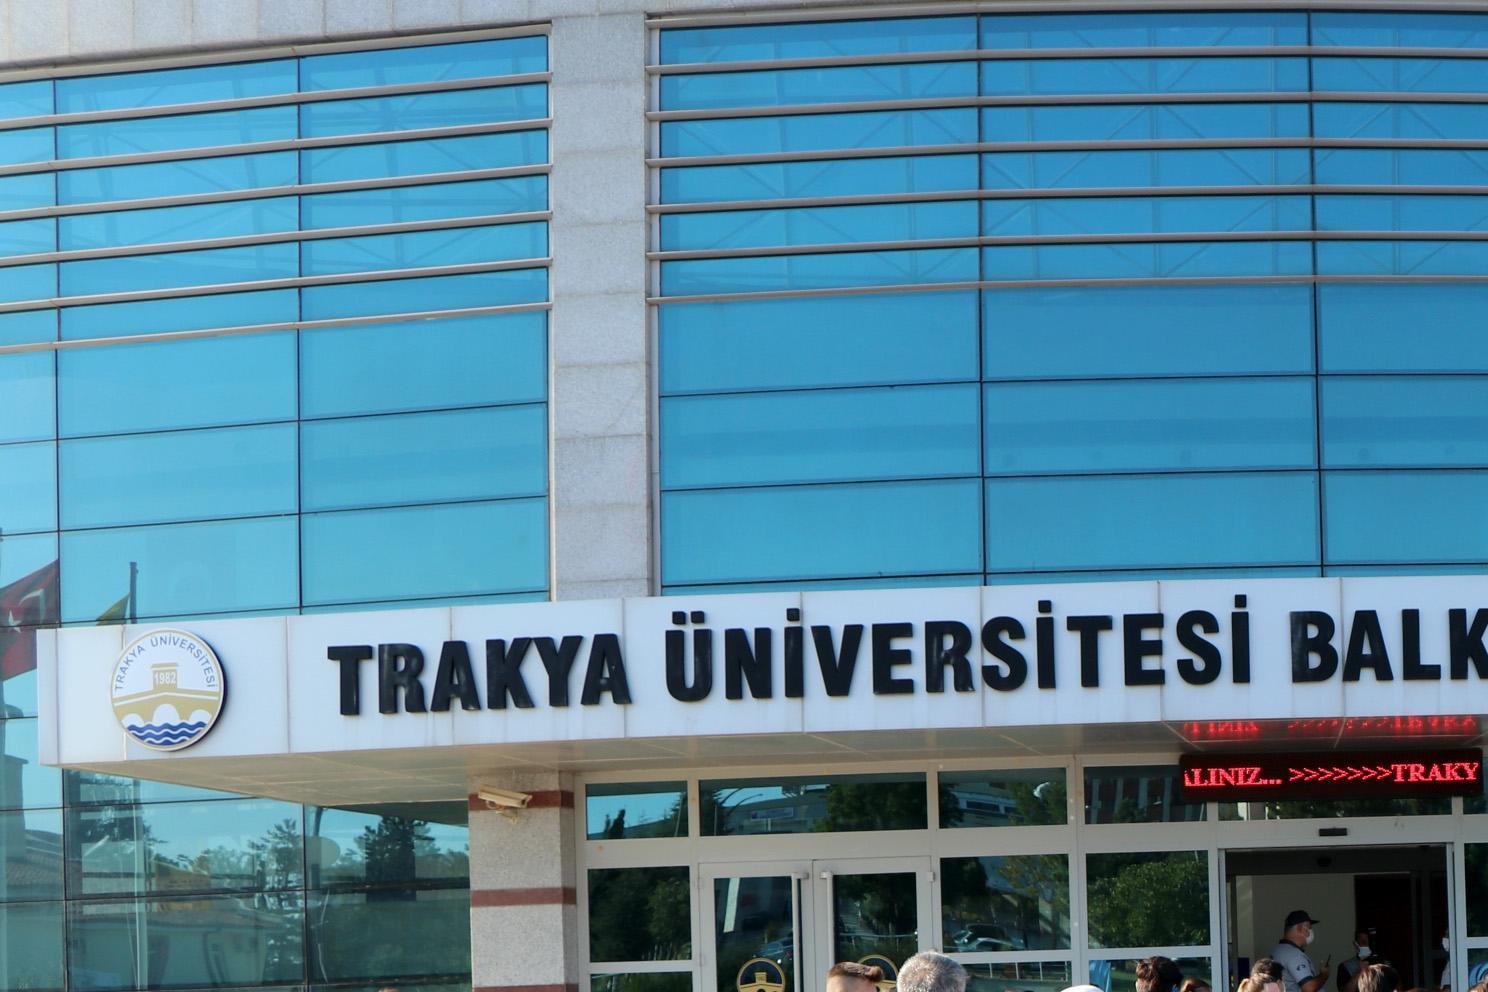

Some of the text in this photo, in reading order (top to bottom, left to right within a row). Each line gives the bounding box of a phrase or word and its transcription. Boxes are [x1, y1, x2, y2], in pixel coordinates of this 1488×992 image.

[115, 633, 217, 690] TRAKYA ÜNİVERSİTESİ
[153, 671, 177, 685] 1982
[327, 632, 633, 716] TRAKYA
[665, 594, 1251, 702] ÜNİVERSİTESİ
